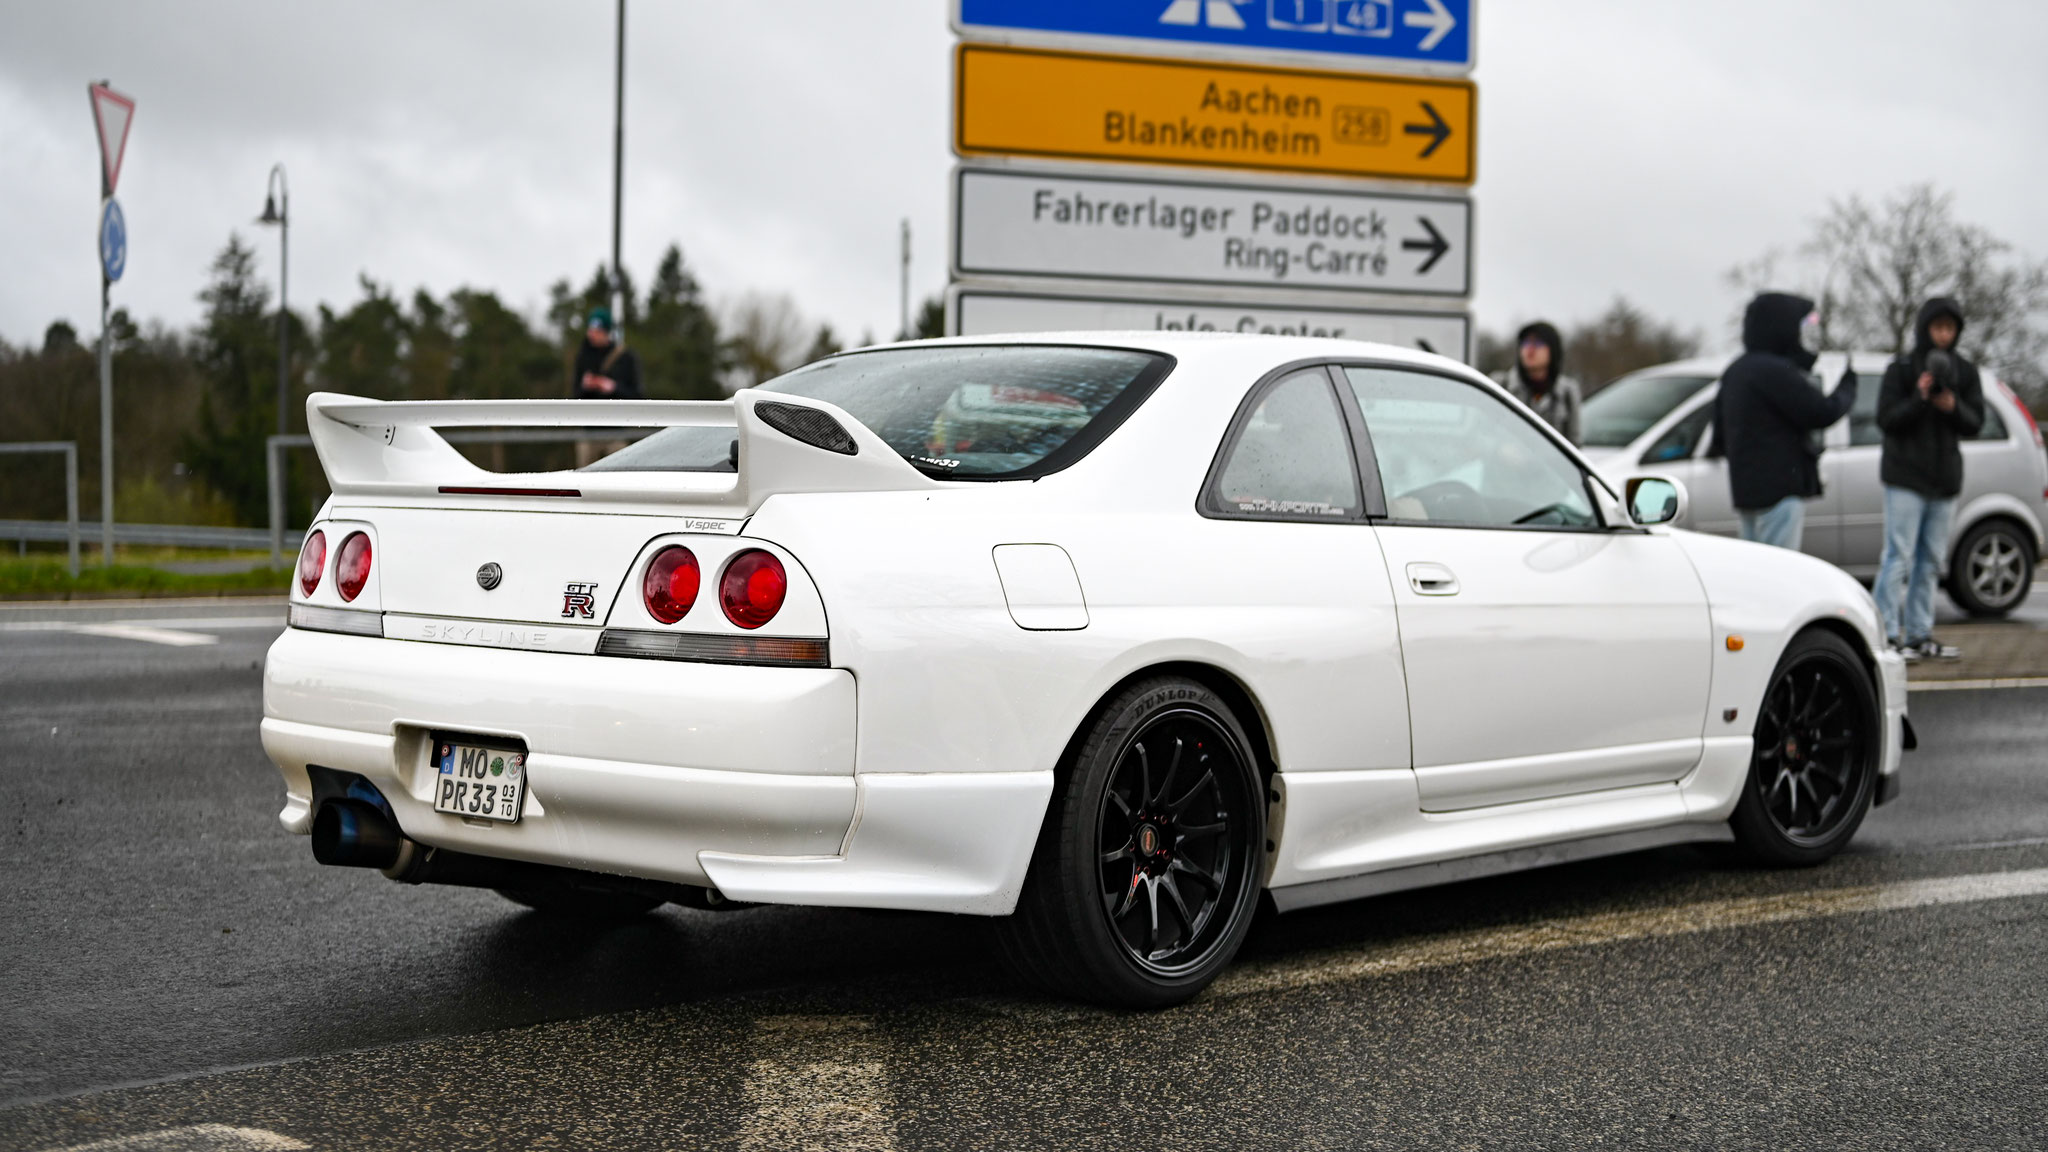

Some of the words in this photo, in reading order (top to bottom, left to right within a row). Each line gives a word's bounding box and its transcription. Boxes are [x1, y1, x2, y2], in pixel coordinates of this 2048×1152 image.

[1201, 81, 1321, 118] Aachen
[1104, 110, 1320, 155] Blankenheim
[1340, 114, 1383, 139] 258
[1034, 189, 1234, 238] Fahrerlager
[1252, 202, 1387, 240] Paddock
[1224, 238, 1388, 279] Ring-Carré
[422, 624, 548, 646] SKYLINE
[1134, 689, 1198, 718] DUNLOP
[460, 748, 488, 779] MO
[502, 784, 516, 798] 03
[501, 803, 513, 817] 10
